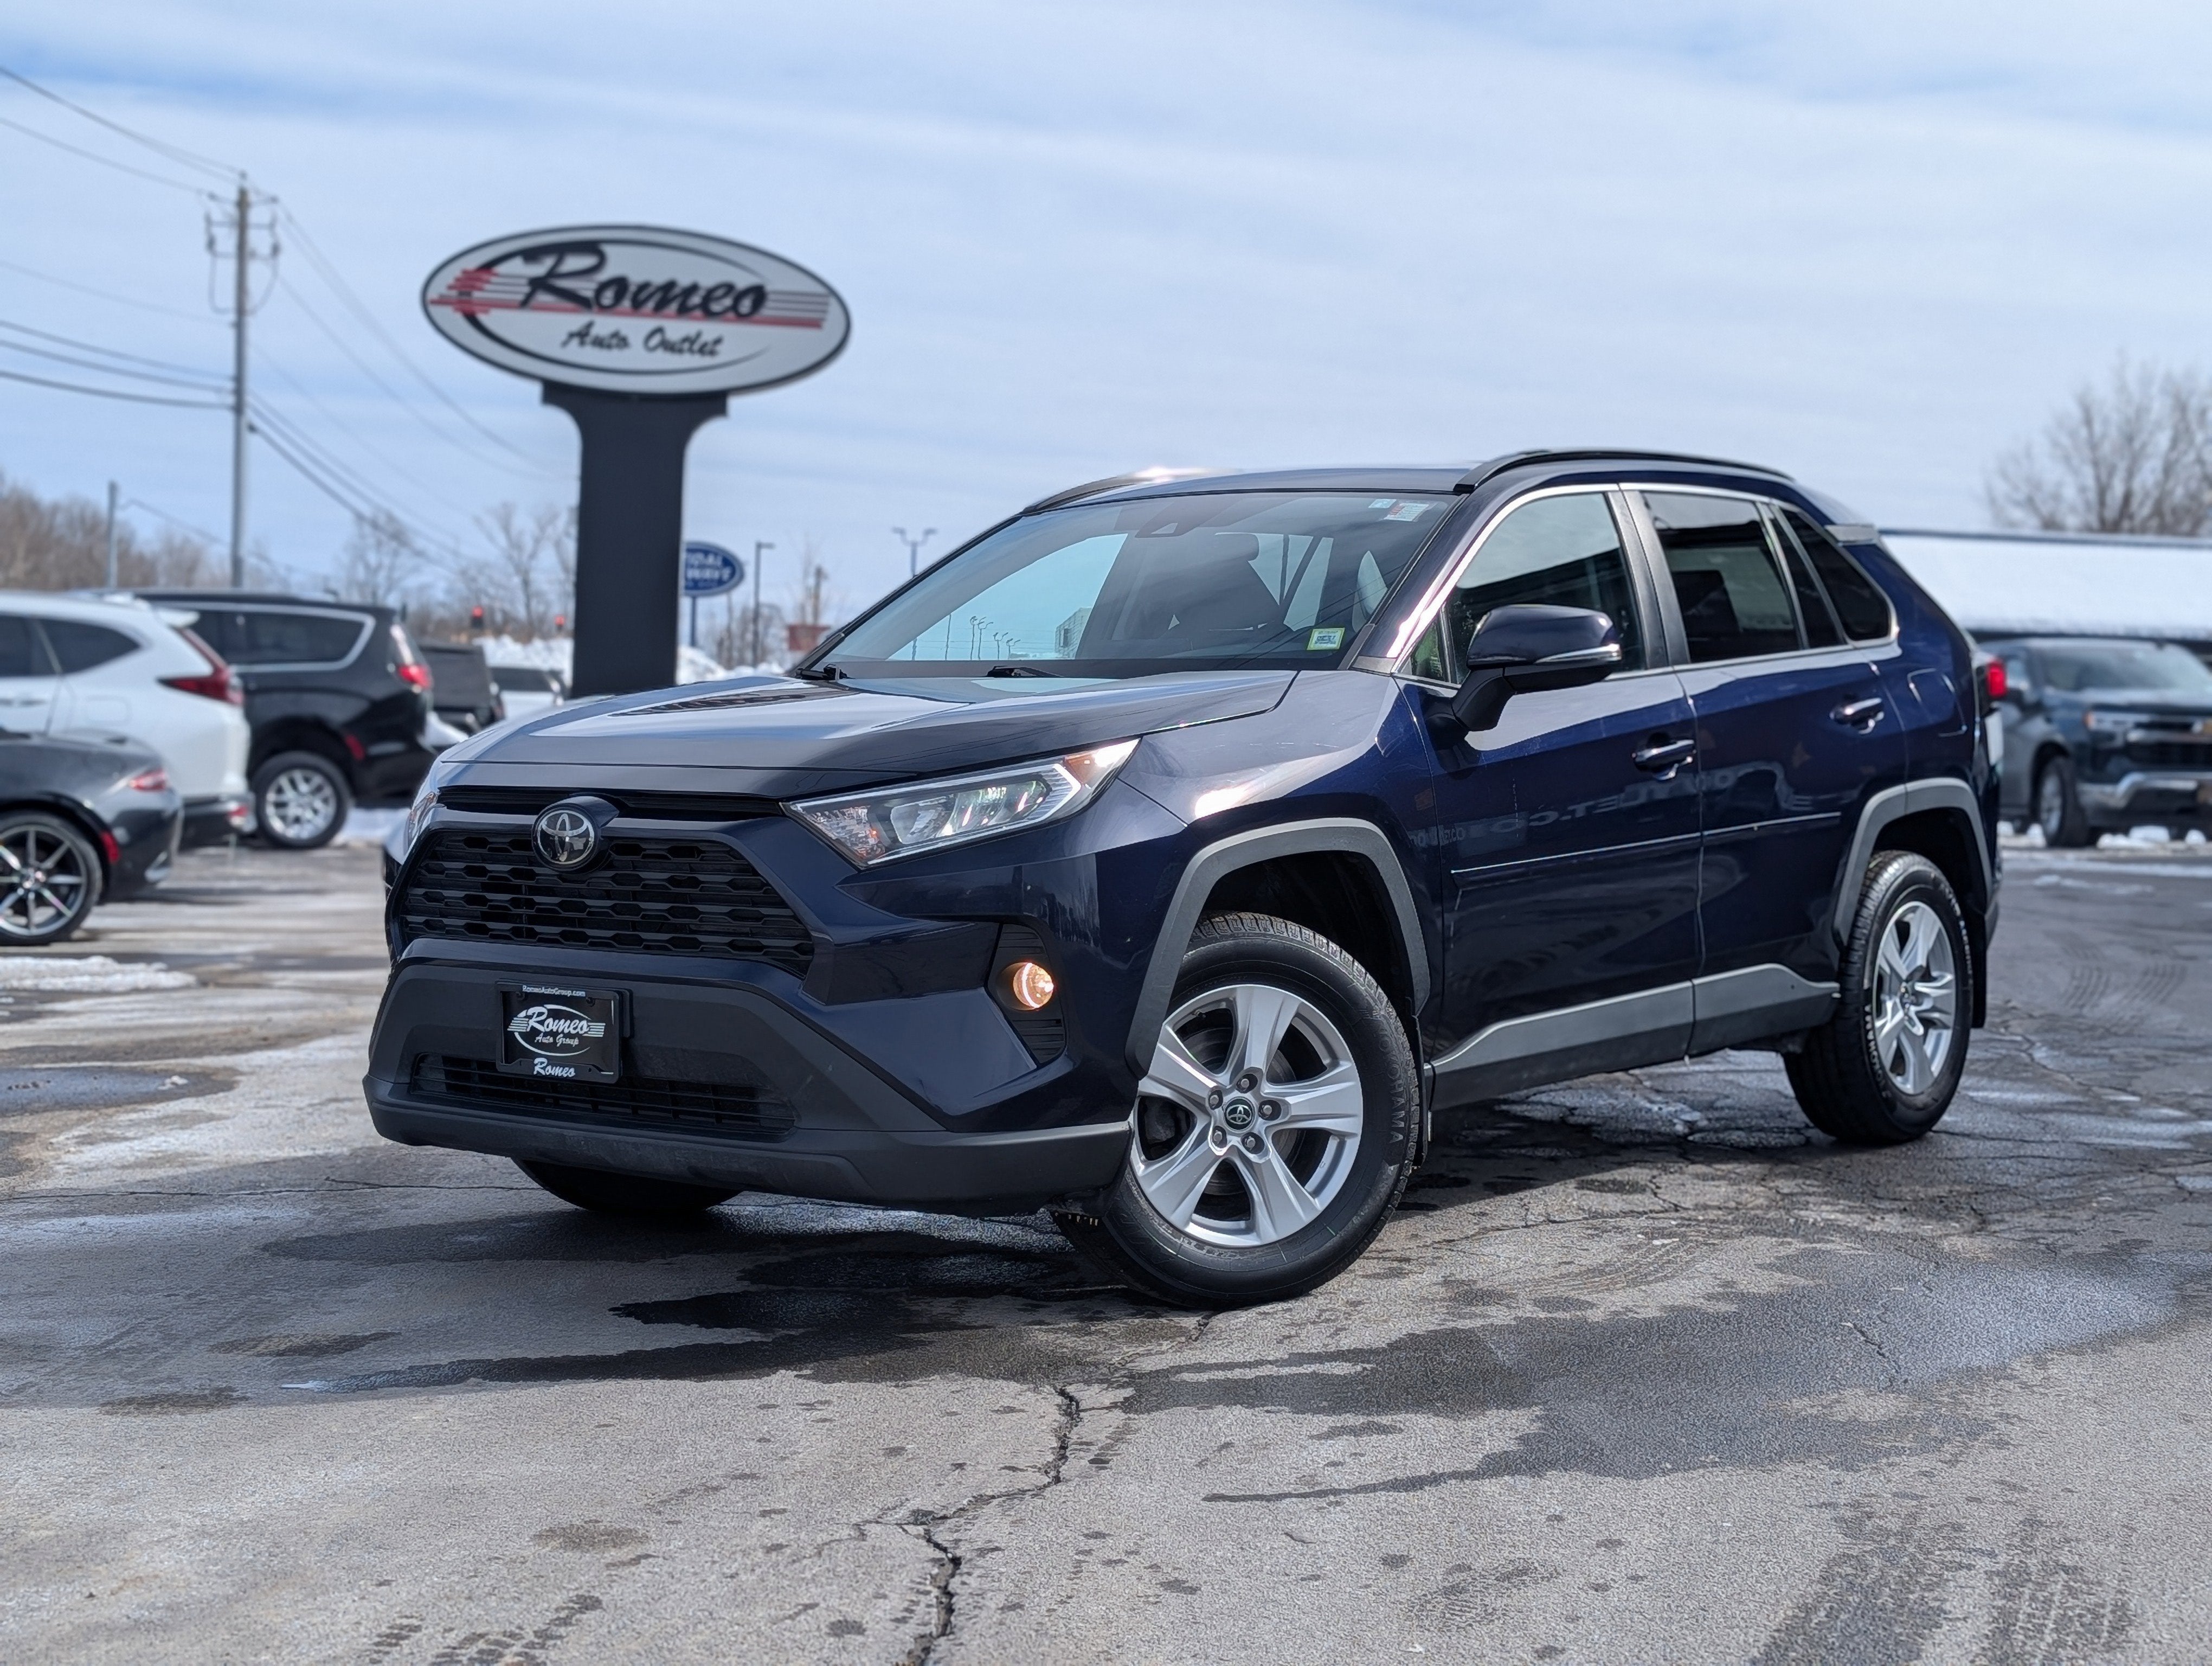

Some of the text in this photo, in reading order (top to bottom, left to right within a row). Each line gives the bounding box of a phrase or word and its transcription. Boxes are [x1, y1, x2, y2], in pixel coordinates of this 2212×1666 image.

[519, 243, 768, 319] Romeo
[561, 321, 724, 357] Auto Outlet
[526, 1006, 590, 1034] Romeo
[534, 1033, 579, 1047] Auto Group
[533, 1058, 576, 1078] Romeo
